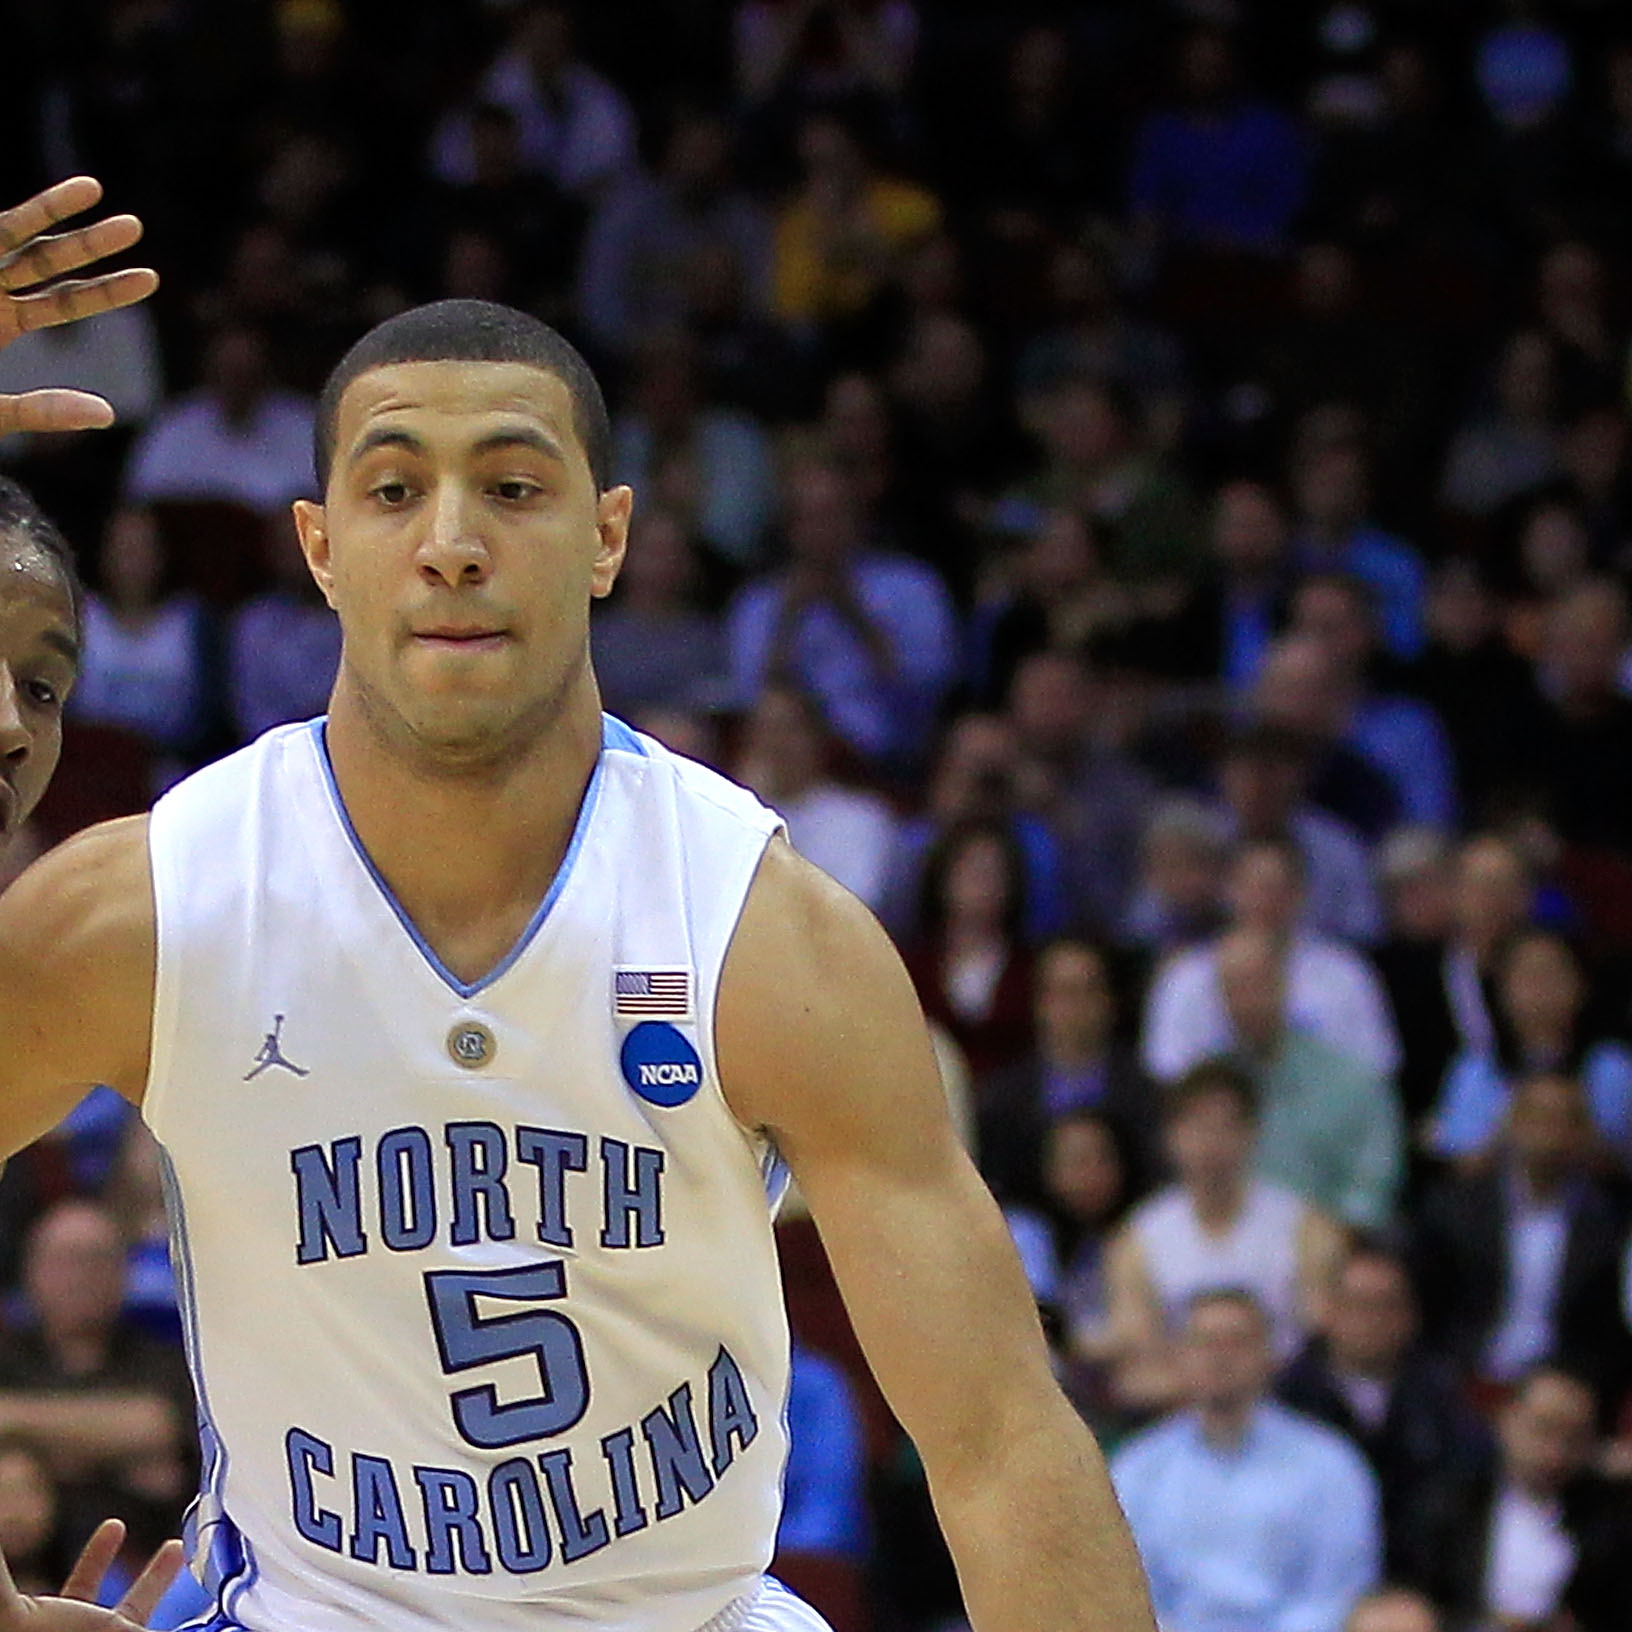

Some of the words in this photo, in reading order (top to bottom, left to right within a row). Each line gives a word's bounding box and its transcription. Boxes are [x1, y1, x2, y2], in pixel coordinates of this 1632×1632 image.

[637, 1062, 700, 1086] NCAA
[290, 1120, 666, 1266] NORTH
[423, 1259, 593, 1450] 5
[284, 1344, 760, 1576] CAROLINA
